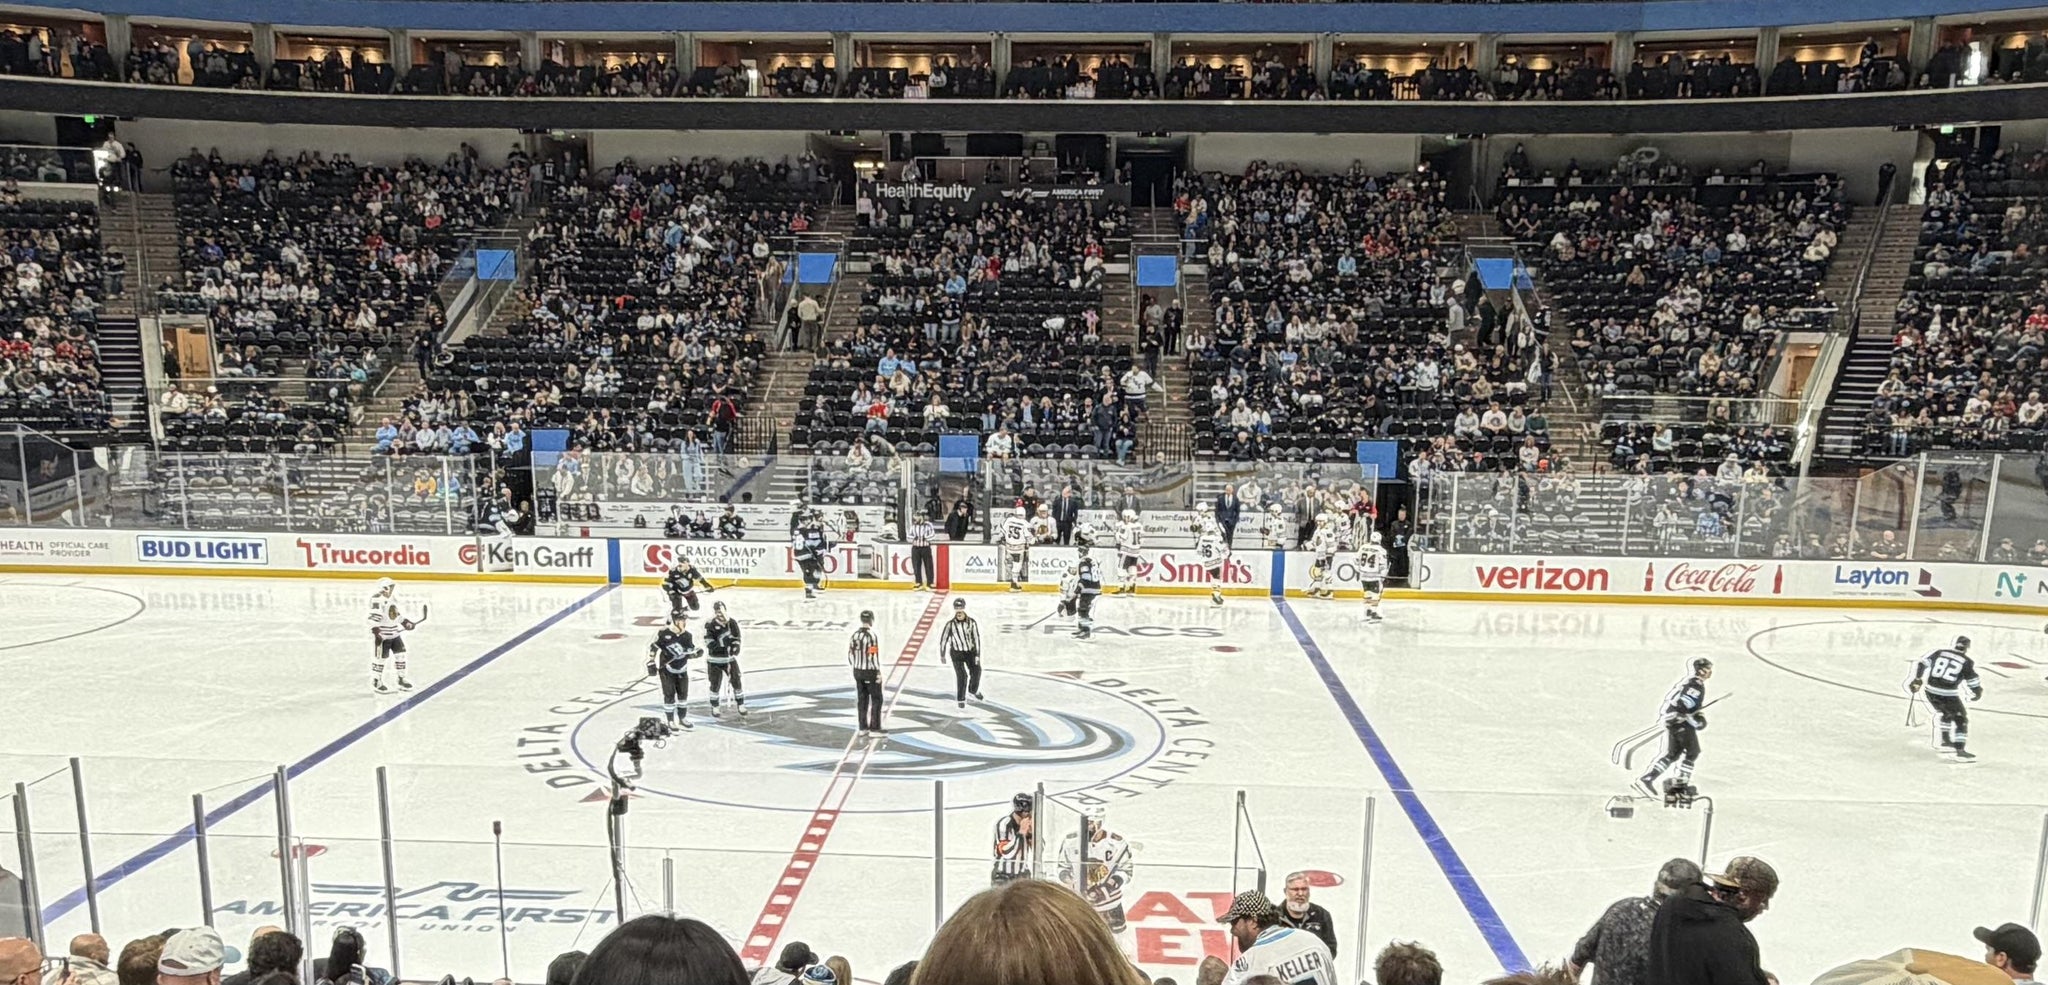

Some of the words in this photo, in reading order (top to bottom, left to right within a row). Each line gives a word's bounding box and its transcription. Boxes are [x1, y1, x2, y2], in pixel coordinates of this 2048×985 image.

[876, 183, 974, 201] HealthEquity
[0, 540, 44, 550] HEALTH
[142, 540, 191, 558] BUD
[195, 542, 263, 560] LIGHT
[316, 543, 431, 566] Trucordia
[488, 543, 529, 567] Ken
[534, 545, 594, 569] Garff
[694, 557, 758, 567] ASSOCIATES
[1476, 560, 1609, 591] verizon
[1664, 562, 1763, 593] Coca-Cola
[1835, 565, 1909, 589] Layton
[737, 619, 850, 628] EALTH
[1931, 656, 1964, 682] 82
[1088, 678, 1209, 728] DELTA
[517, 724, 596, 789] DELTA
[1060, 737, 1215, 805] CENTER
[1105, 850, 1113, 861] C
[213, 900, 450, 919] AMERICA
[462, 906, 616, 924] FIRST
[419, 923, 517, 932] UNION
[1276, 951, 1322, 981] KELLER
